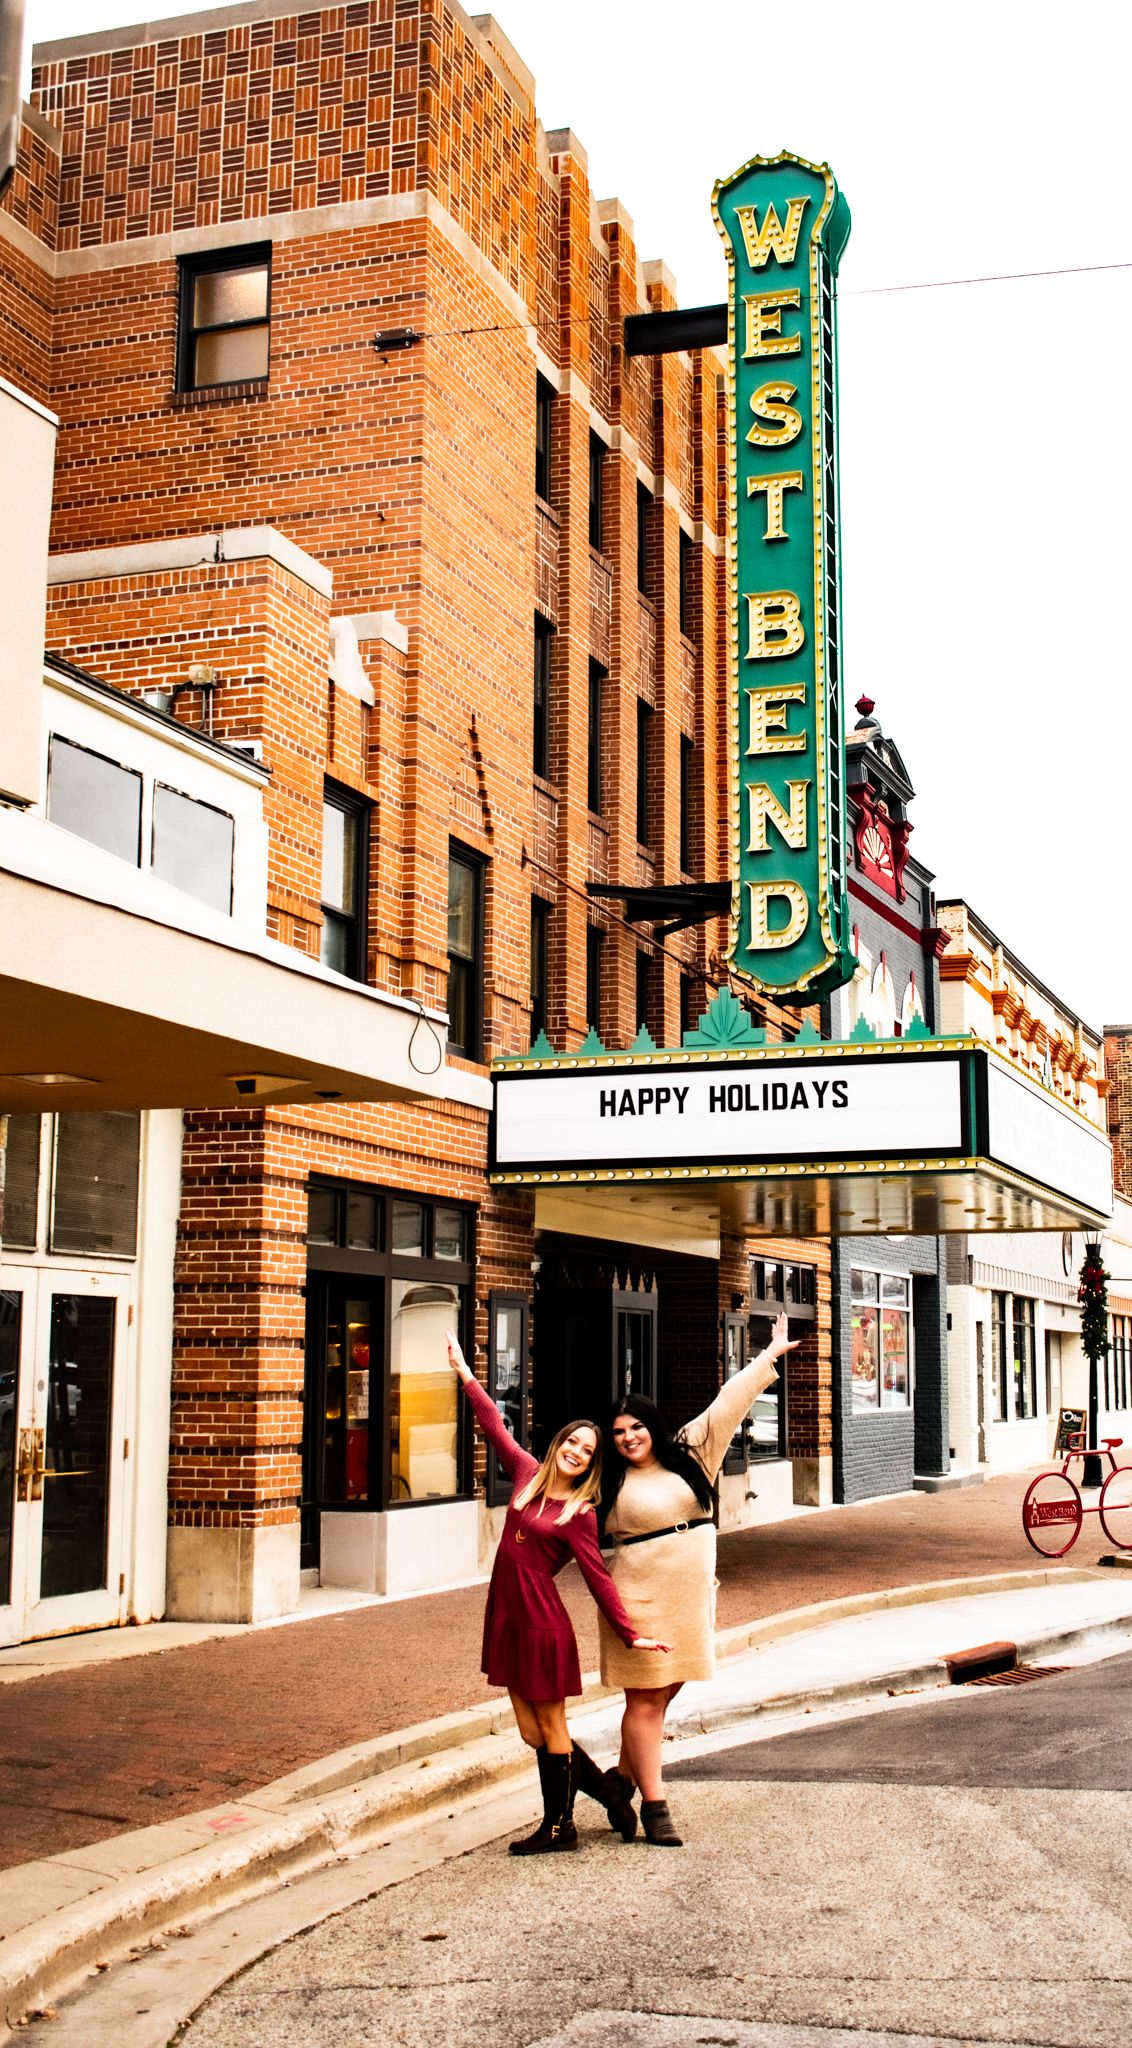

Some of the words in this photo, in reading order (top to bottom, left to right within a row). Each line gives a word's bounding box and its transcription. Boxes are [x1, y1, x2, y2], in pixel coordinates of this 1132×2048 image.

[733, 195, 811, 541] WEST
[742, 590, 811, 951] BEND
[599, 1086, 690, 1117] HAPPY
[709, 1080, 849, 1113] HOLIDAYS
